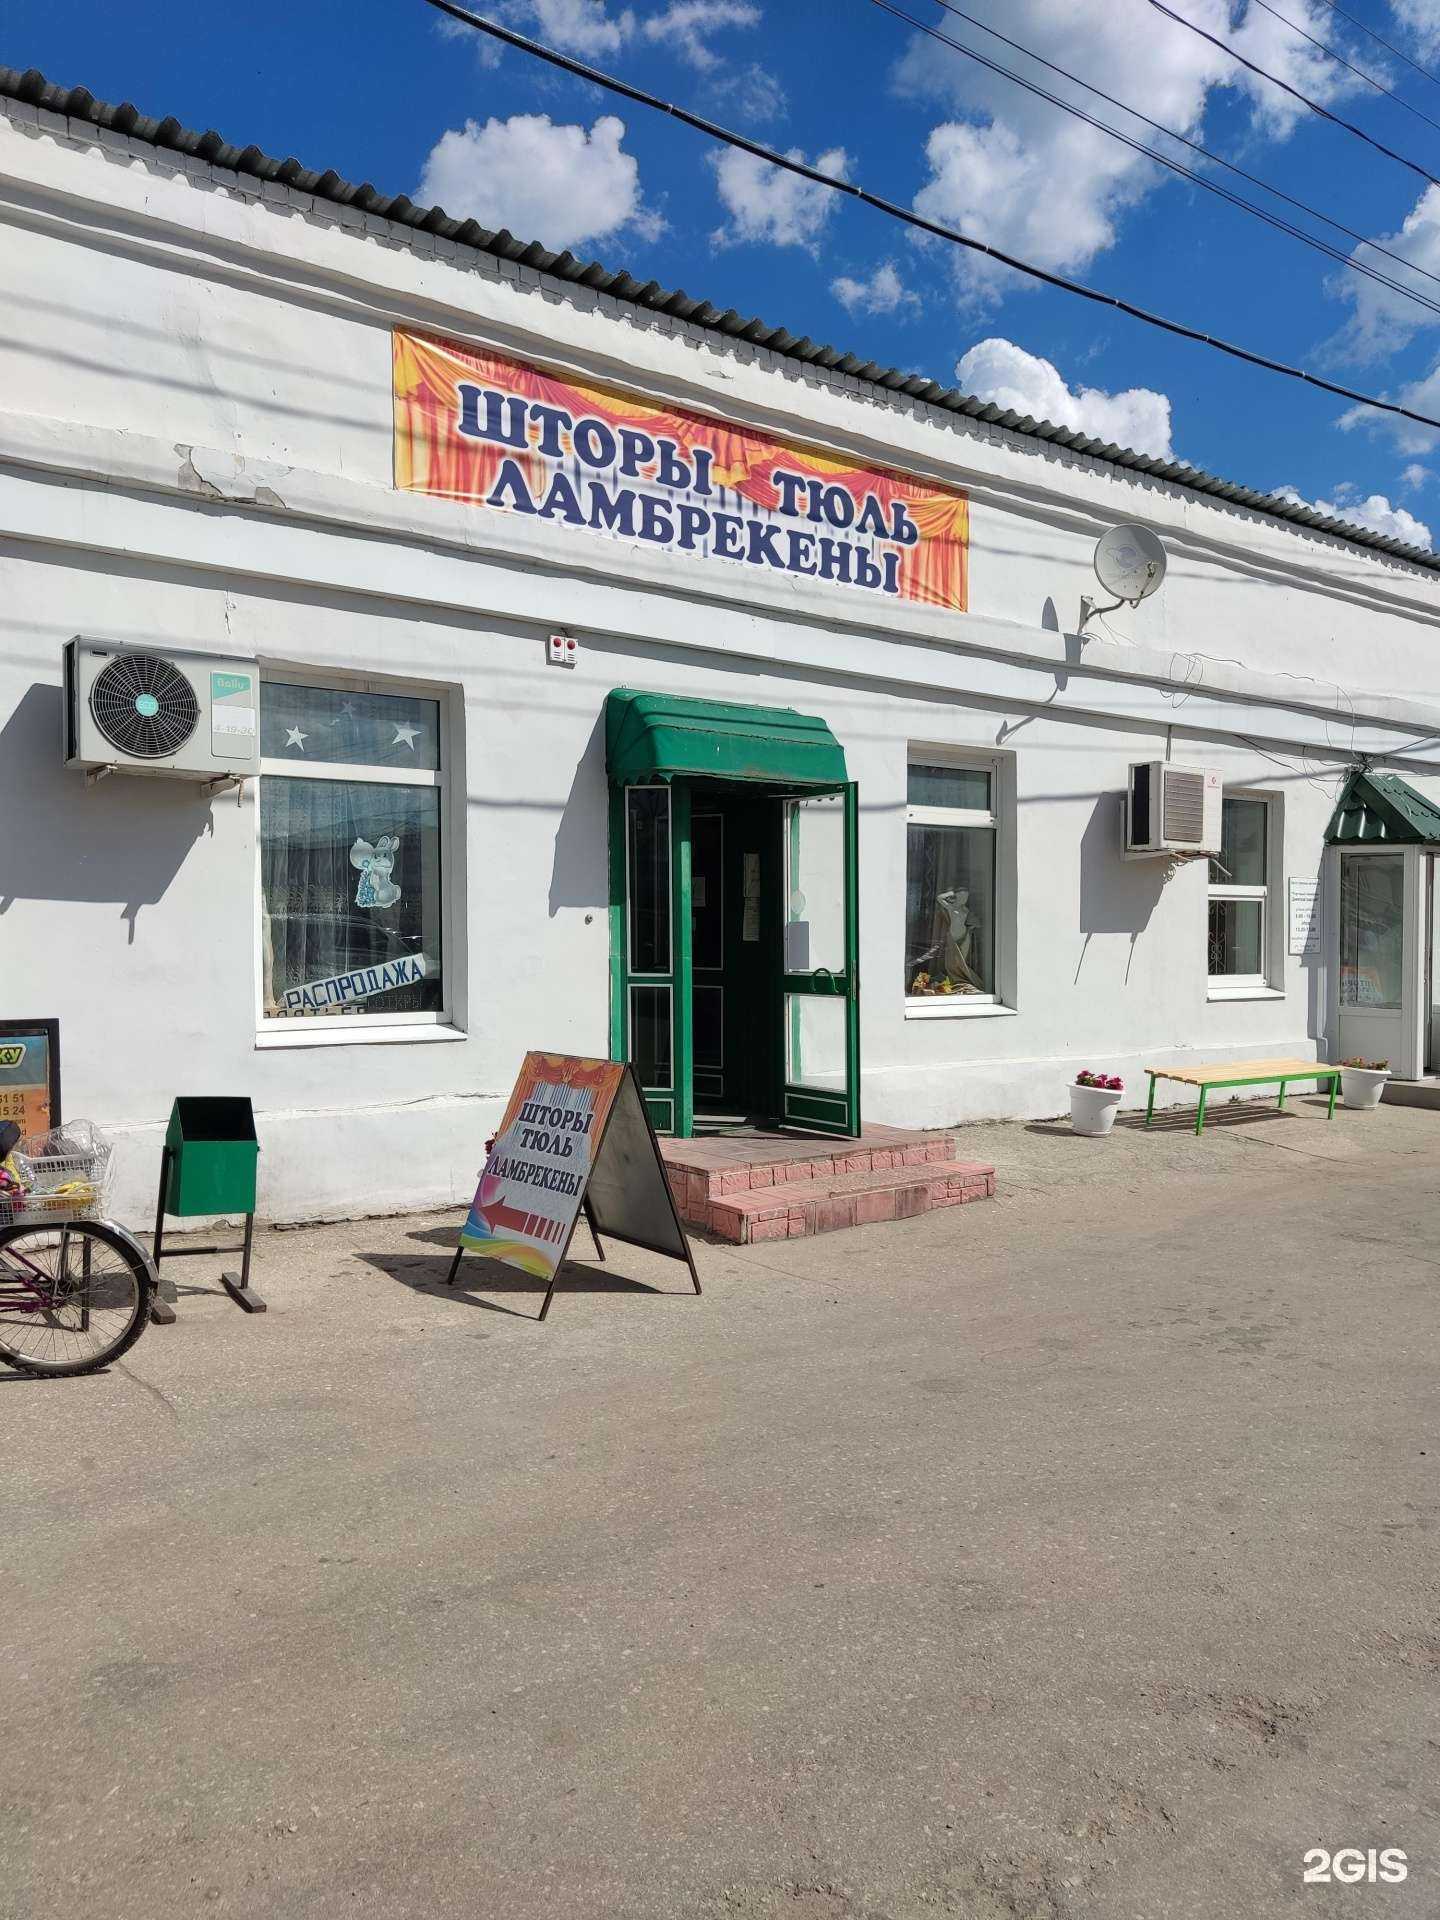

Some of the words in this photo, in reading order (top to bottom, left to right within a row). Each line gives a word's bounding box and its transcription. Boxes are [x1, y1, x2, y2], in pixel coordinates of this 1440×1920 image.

[457, 384, 714, 496] ШТОРЫ
[772, 470, 918, 546] ТЮЛЬ
[486, 459, 900, 594] ЛАМБРЕКЕНЫ
[286, 957, 425, 1009] РАСПРОДАЖА
[518, 1102, 594, 1134] ШТОРЫ
[520, 1128, 573, 1158] ТЮЛЬ
[487, 1155, 584, 1197] ЛАМБРЕКЕНЫ
